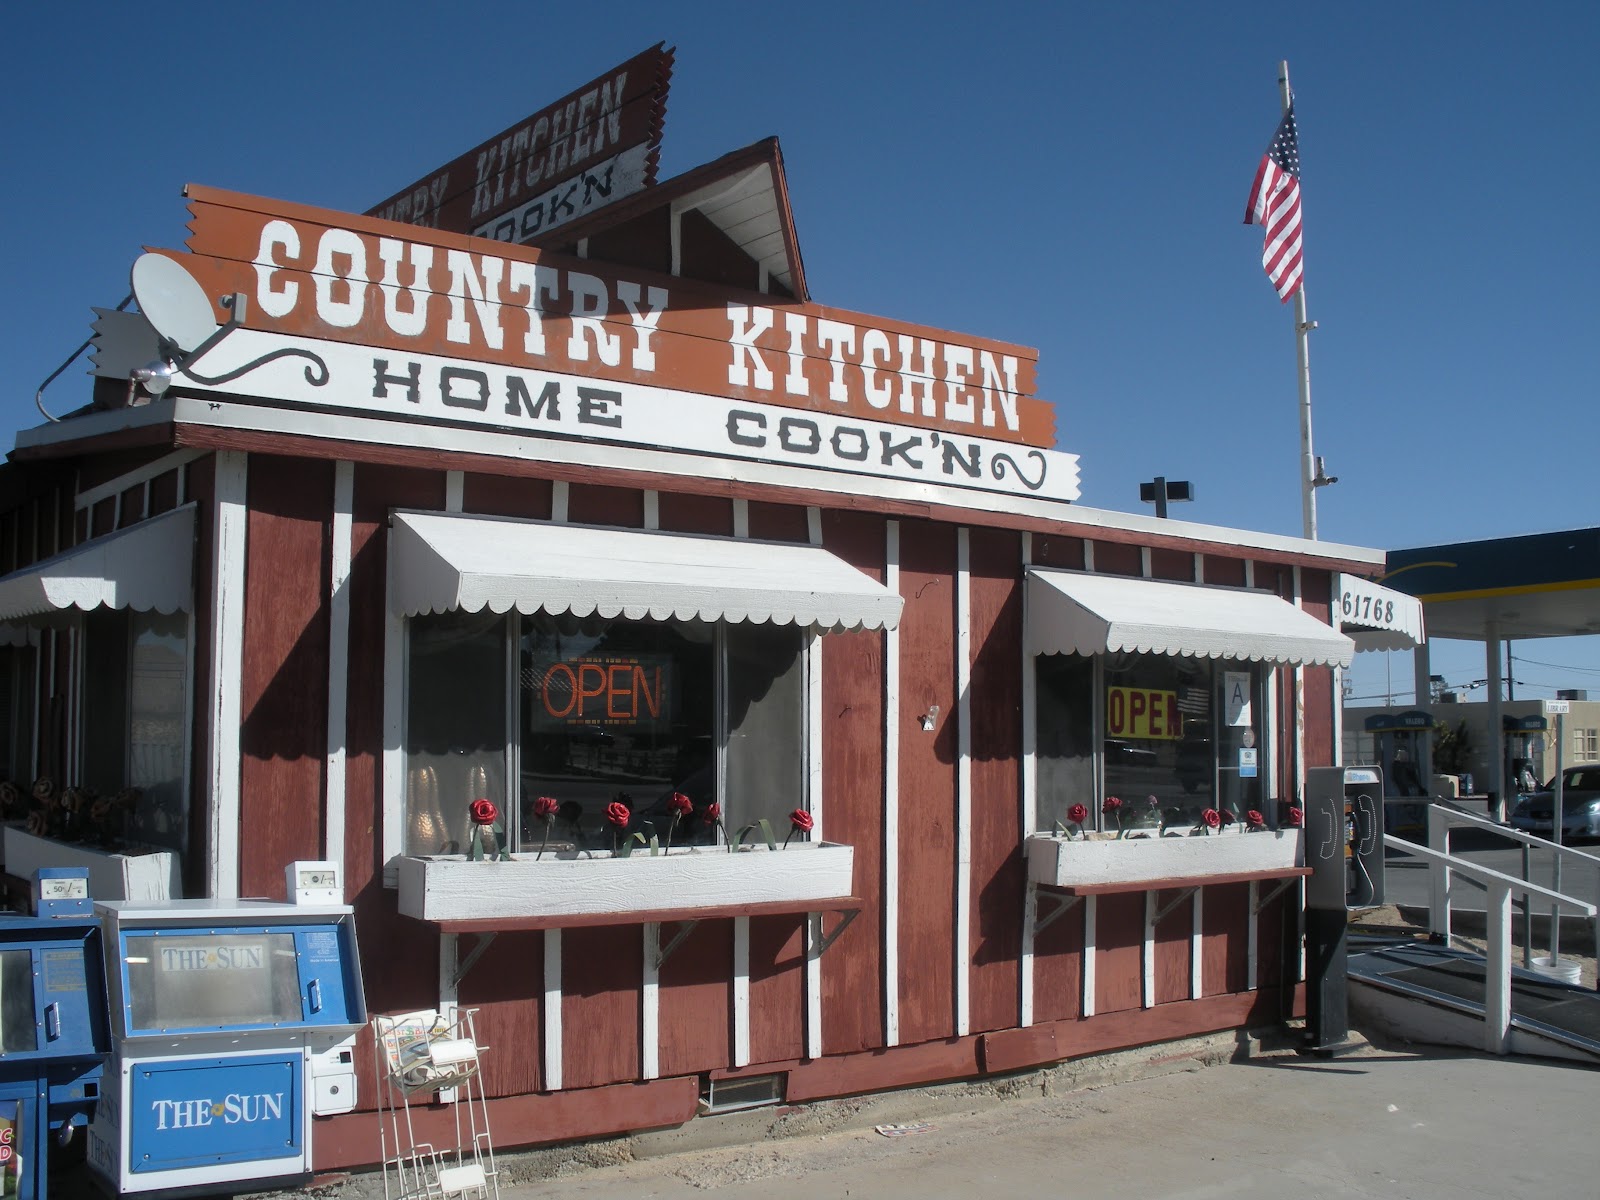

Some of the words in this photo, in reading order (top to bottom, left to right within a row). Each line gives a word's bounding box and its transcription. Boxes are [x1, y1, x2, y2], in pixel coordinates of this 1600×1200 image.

[470, 71, 628, 218] KITCHEN
[471, 163, 614, 244] OOK'N
[252, 219, 669, 372] COUNTRY
[727, 301, 1020, 431] KITCHEN
[372, 358, 622, 429] HOME
[725, 409, 981, 478] COOK'N
[1342, 592, 1394, 623] 61768
[543, 663, 661, 717] OPEN
[1110, 689, 1182, 737] OPEN
[1232, 682, 1244, 703] A
[1547, 704, 1568, 713] LIBRARY
[163, 948, 207, 970] THE
[217, 946, 260, 969] SUN
[152, 1099, 213, 1130] THE
[224, 1093, 284, 1124] SUN
